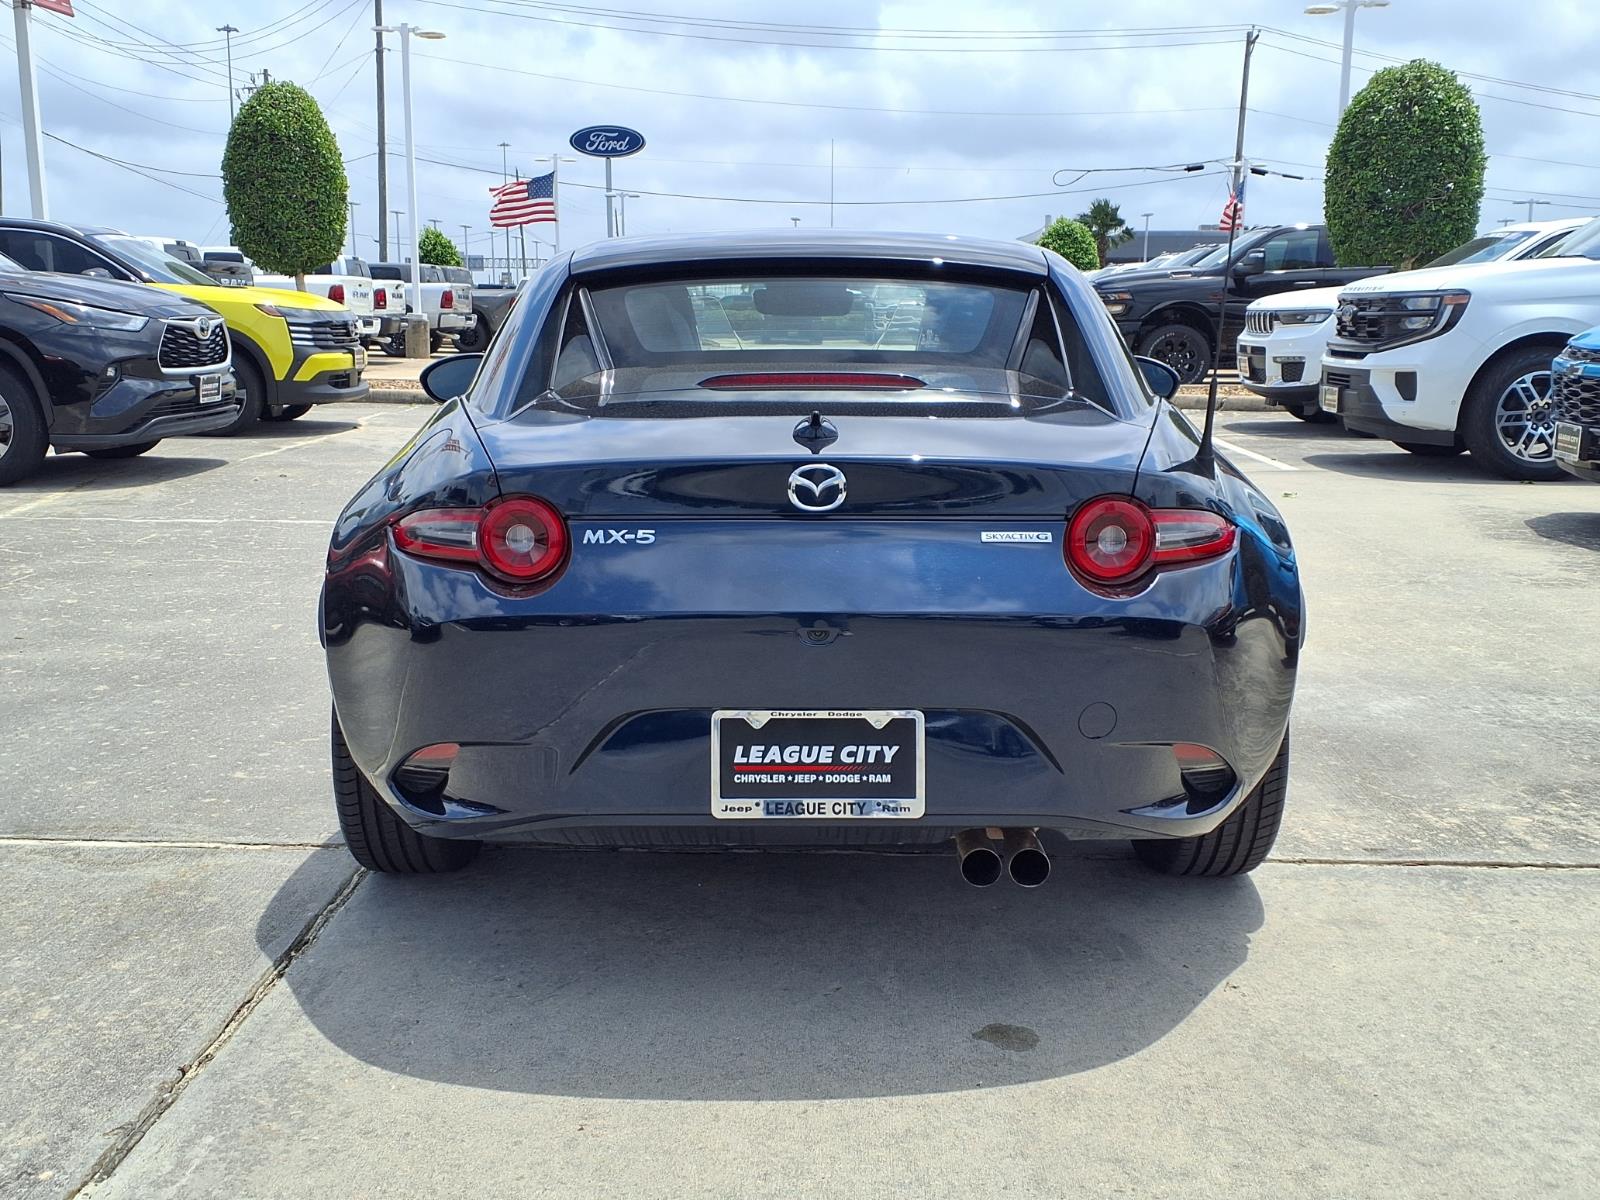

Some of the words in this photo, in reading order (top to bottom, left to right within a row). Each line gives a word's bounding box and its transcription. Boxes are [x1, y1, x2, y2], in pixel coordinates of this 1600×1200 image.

[585, 131, 630, 151] Ford
[582, 529, 656, 545] MX-5
[733, 745, 835, 763] LEAGUE
[840, 745, 900, 763] CITY
[734, 774, 786, 783] CHRYSLER
[793, 774, 817, 783] JEEP
[825, 774, 861, 783] DODGE
[869, 774, 892, 783] RAM
[721, 804, 753, 813] Jeep
[765, 802, 827, 816] LEAGUE
[831, 802, 867, 816] CITY
[881, 804, 911, 813] Ram
